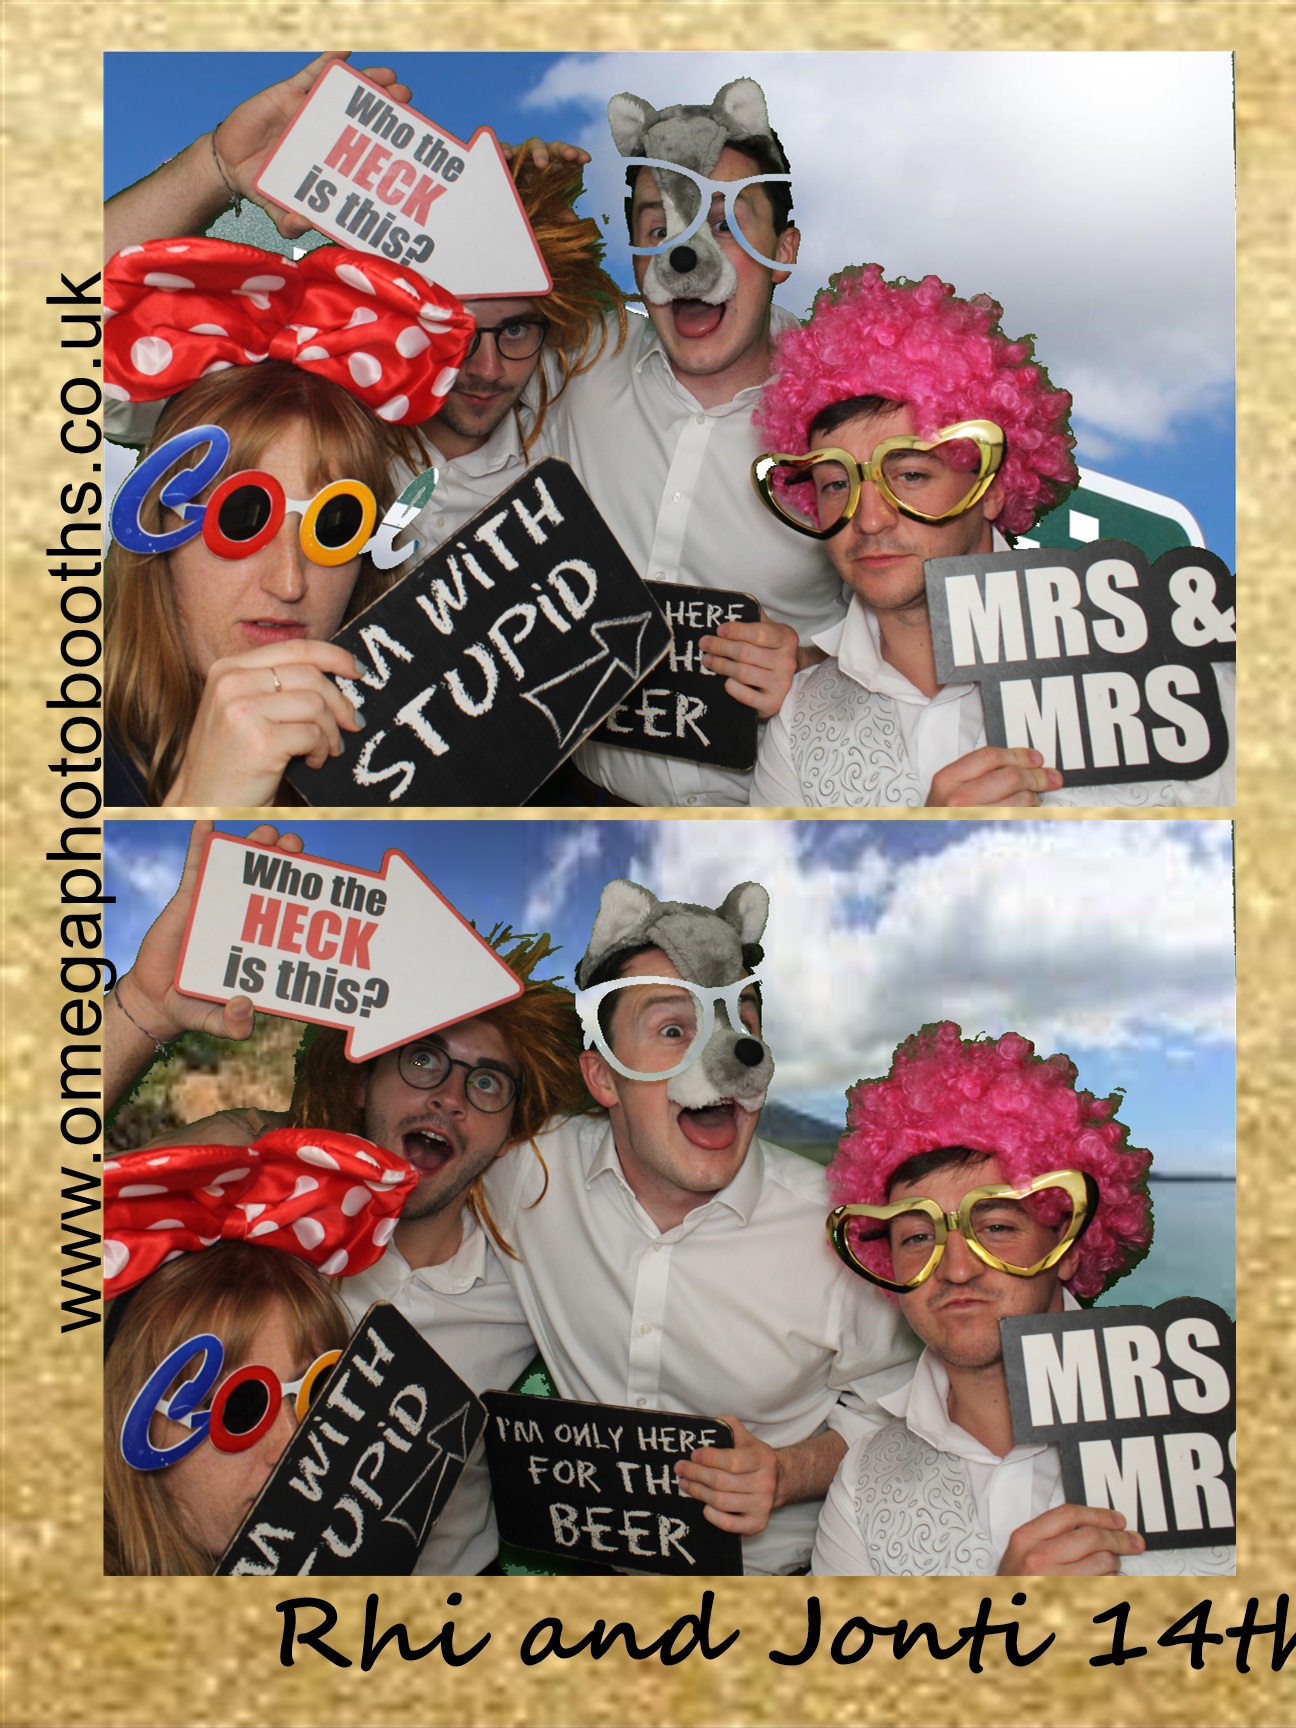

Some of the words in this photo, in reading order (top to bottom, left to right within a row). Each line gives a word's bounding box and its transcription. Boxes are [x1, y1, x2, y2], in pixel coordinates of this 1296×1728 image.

[326, 125, 447, 227] HECK
[344, 85, 414, 149] Who
[413, 133, 464, 183] the
[294, 165, 338, 214] is
[335, 198, 435, 266] this?
[945, 558, 1149, 668] MRS
[1168, 565, 1236, 648] &
[1000, 664, 1211, 772] MRS
[240, 893, 380, 971] HECK
[242, 851, 323, 902] Who
[332, 876, 387, 917] the
[222, 946, 267, 993] is
[274, 961, 390, 1018] this?
[1021, 1317, 1231, 1428] MRS
[496, 1416, 544, 1443] I'M
[554, 1423, 624, 1453] ONLY
[528, 1455, 601, 1493] FOR
[1079, 1431, 1236, 1535] MR
[549, 1502, 696, 1565] BEER
